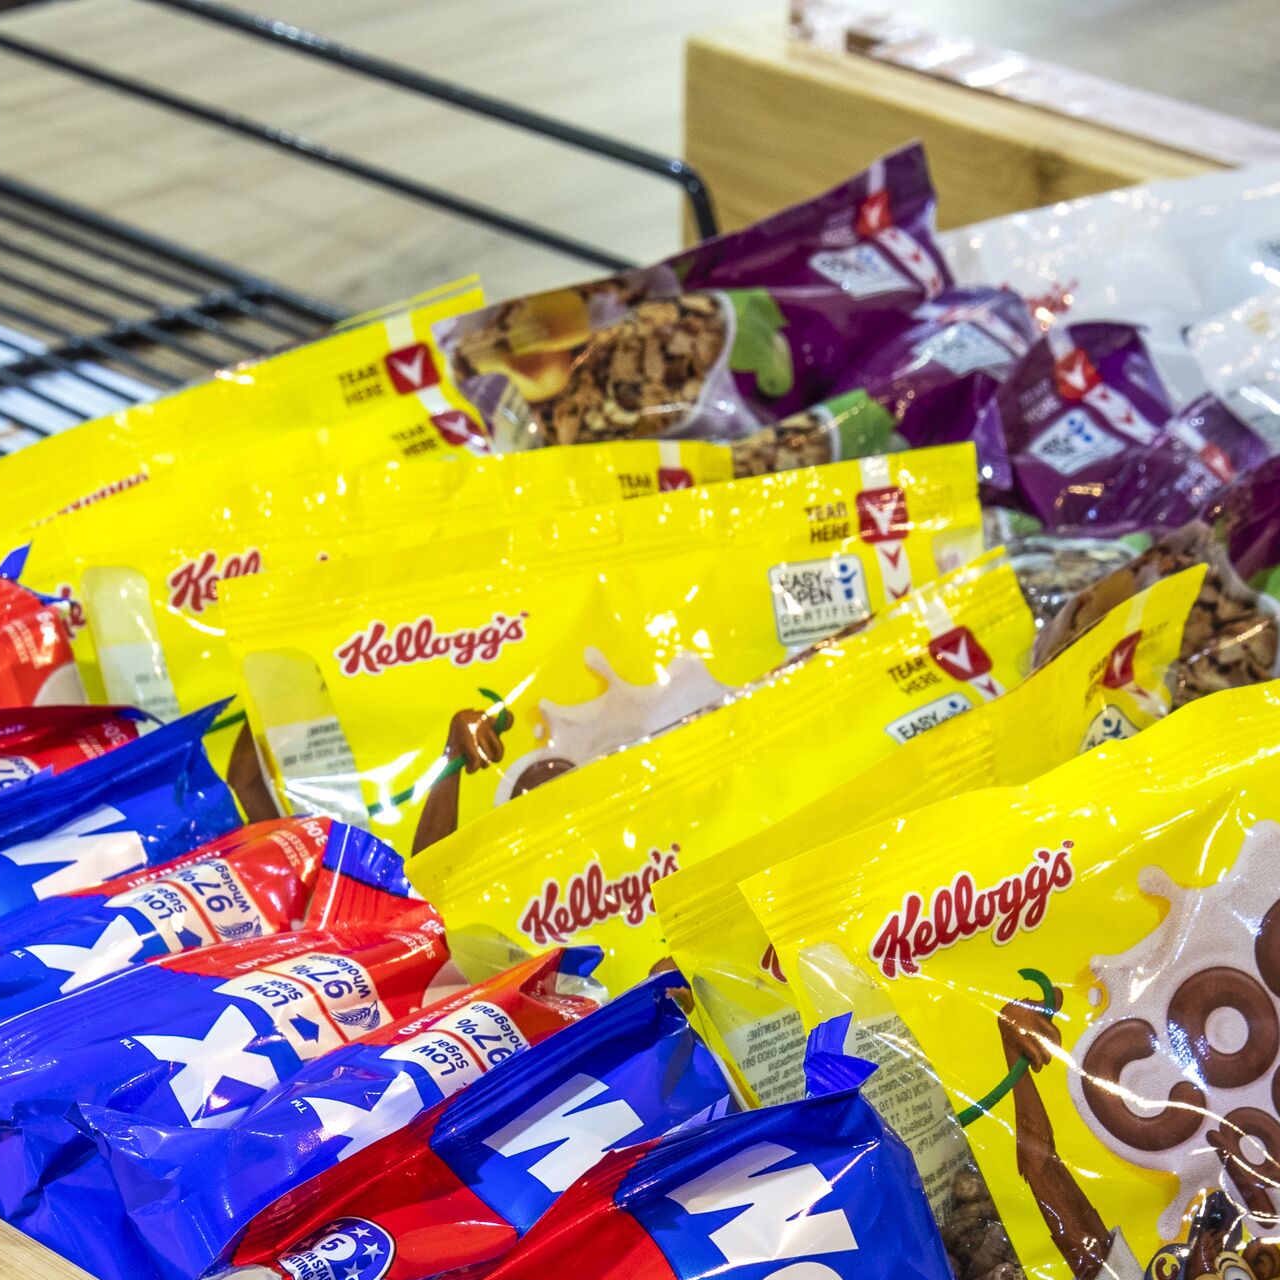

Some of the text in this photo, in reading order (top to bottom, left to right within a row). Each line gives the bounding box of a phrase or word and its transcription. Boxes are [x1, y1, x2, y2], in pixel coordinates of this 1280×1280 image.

[811, 523, 850, 544] HERE
[782, 603, 856, 626] CERTIFIE
[337, 613, 524, 674] Kellogg's
[887, 657, 927, 683] TEAR
[897, 712, 941, 740] EASY
[872, 851, 1072, 976] Kellogg's
[291, 964, 354, 999] 97%
[456, 1017, 511, 1069] 97%
[471, 1003, 530, 1053] holegrain
[321, 1237, 347, 1251] 5
